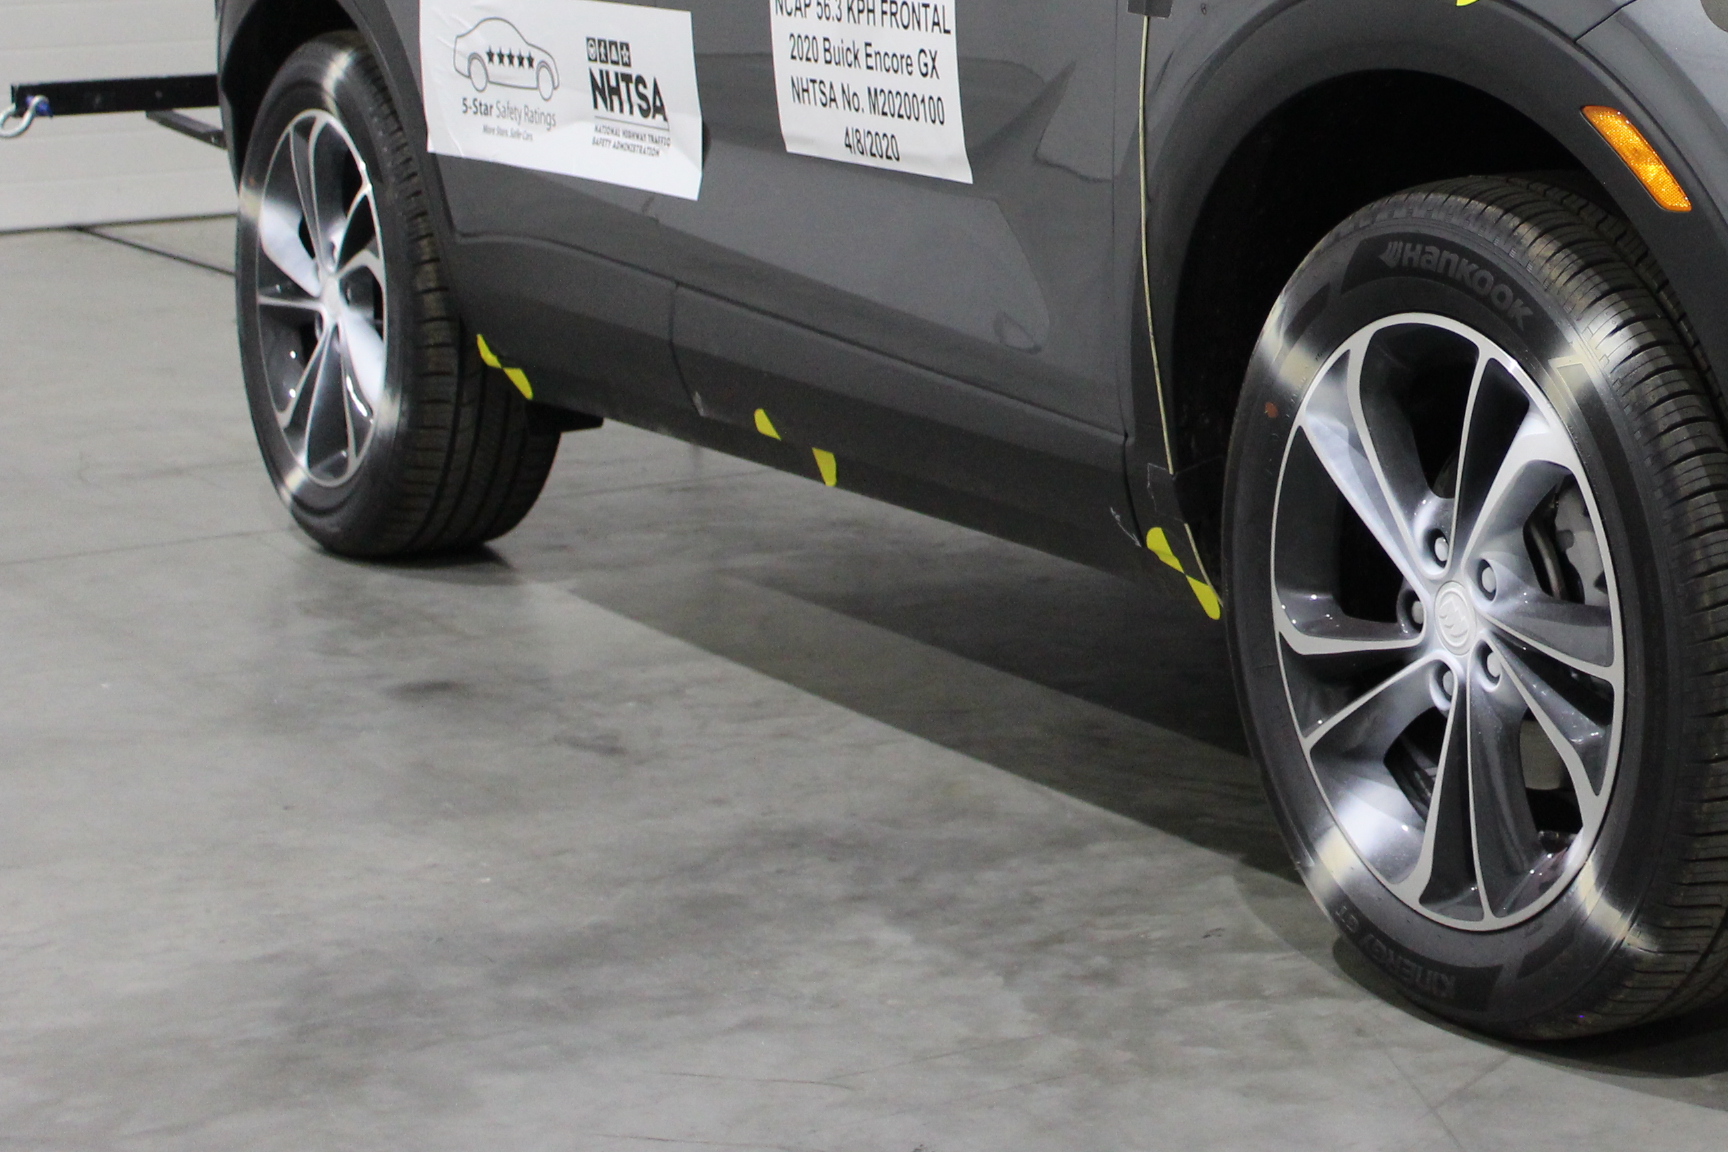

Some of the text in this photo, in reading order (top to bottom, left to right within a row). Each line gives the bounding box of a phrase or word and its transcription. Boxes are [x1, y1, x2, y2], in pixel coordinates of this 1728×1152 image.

[788, 33, 940, 80] 2020 Buick Encore GX
[461, 97, 557, 131] 5-Star Safety Ratings
[588, 66, 669, 123] NHTSA
[790, 75, 945, 126] NHTSA No. M20200100
[844, 126, 900, 162] 4/8/2020
